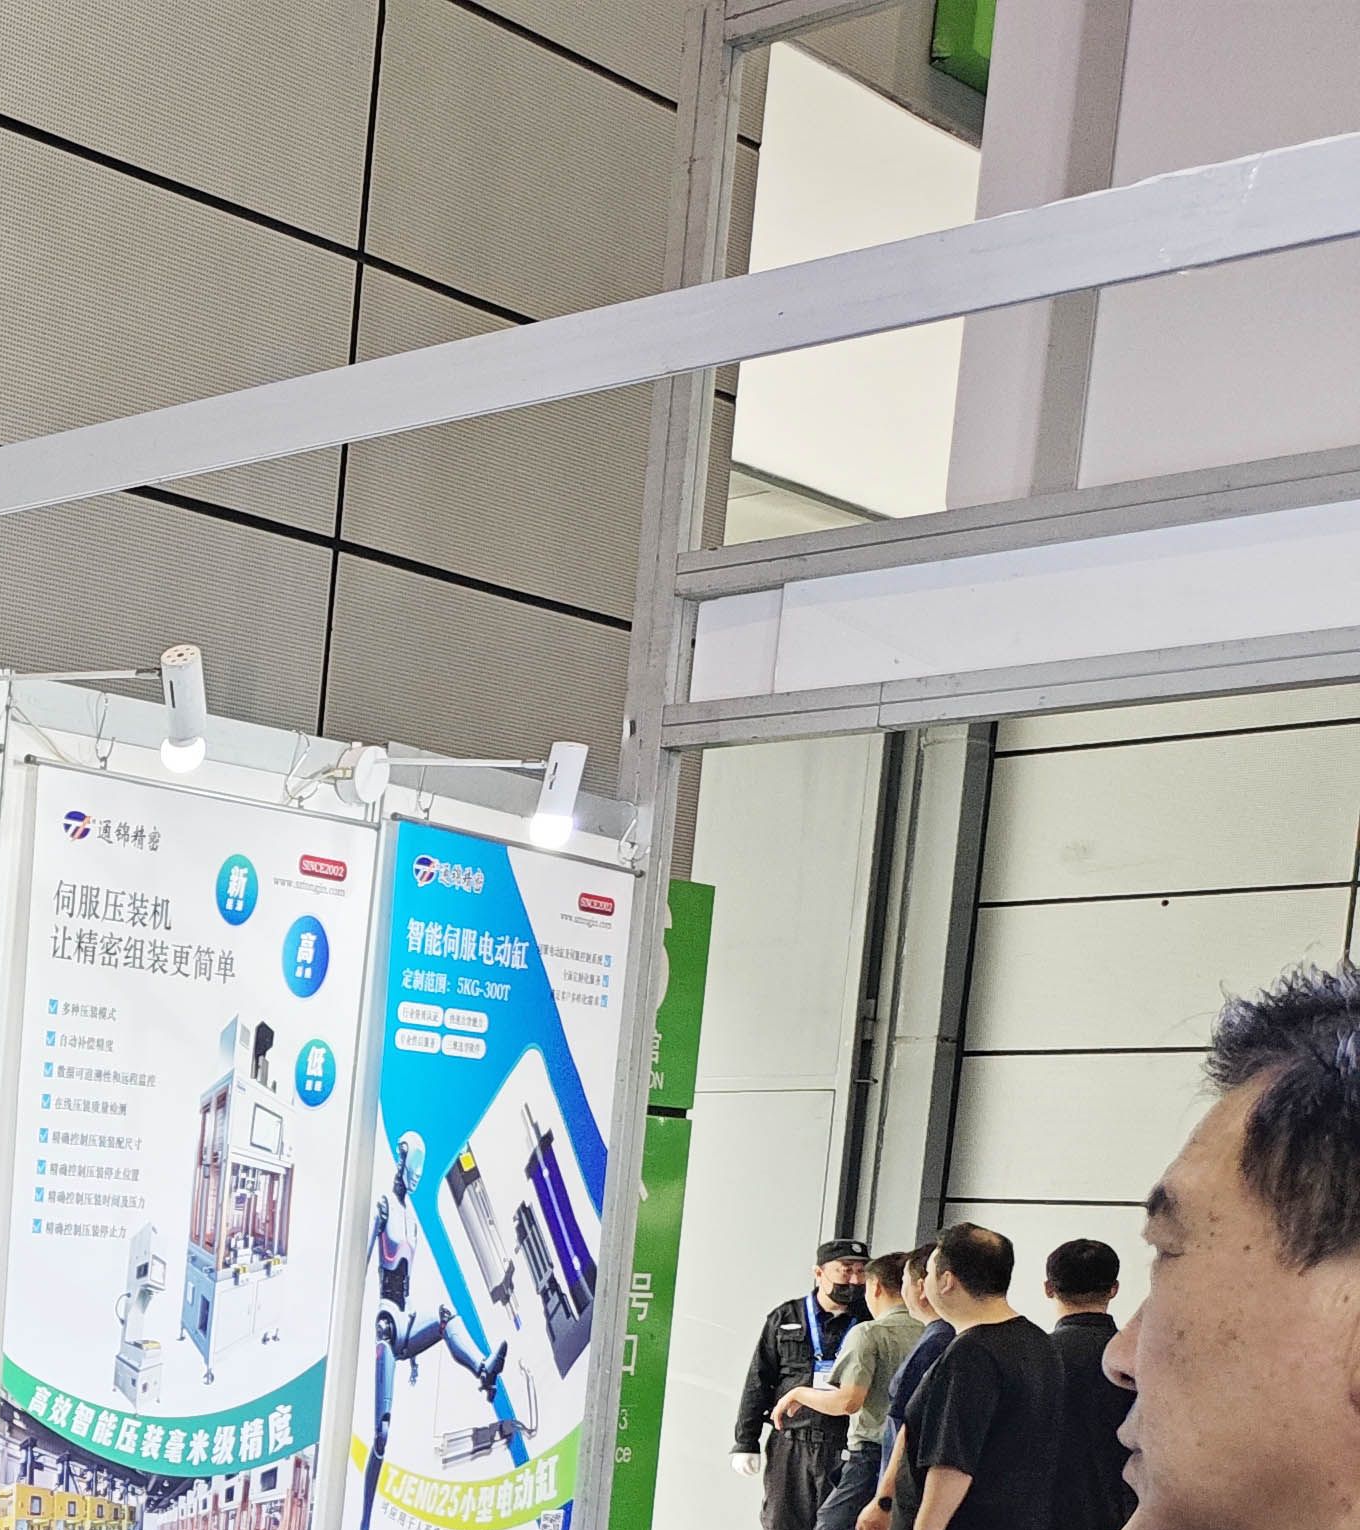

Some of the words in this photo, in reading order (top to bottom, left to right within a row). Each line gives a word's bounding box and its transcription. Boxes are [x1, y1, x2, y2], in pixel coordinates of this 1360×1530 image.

[97, 819, 161, 851] 通锦精密
[54, 880, 172, 932] 伺服压装机
[50, 924, 236, 985] 让精密组装更简单
[296, 932, 317, 964] 高
[406, 918, 530, 971] 智能伺服电动缸
[29, 1386, 294, 1466] 高效智能压装毫米级精度
